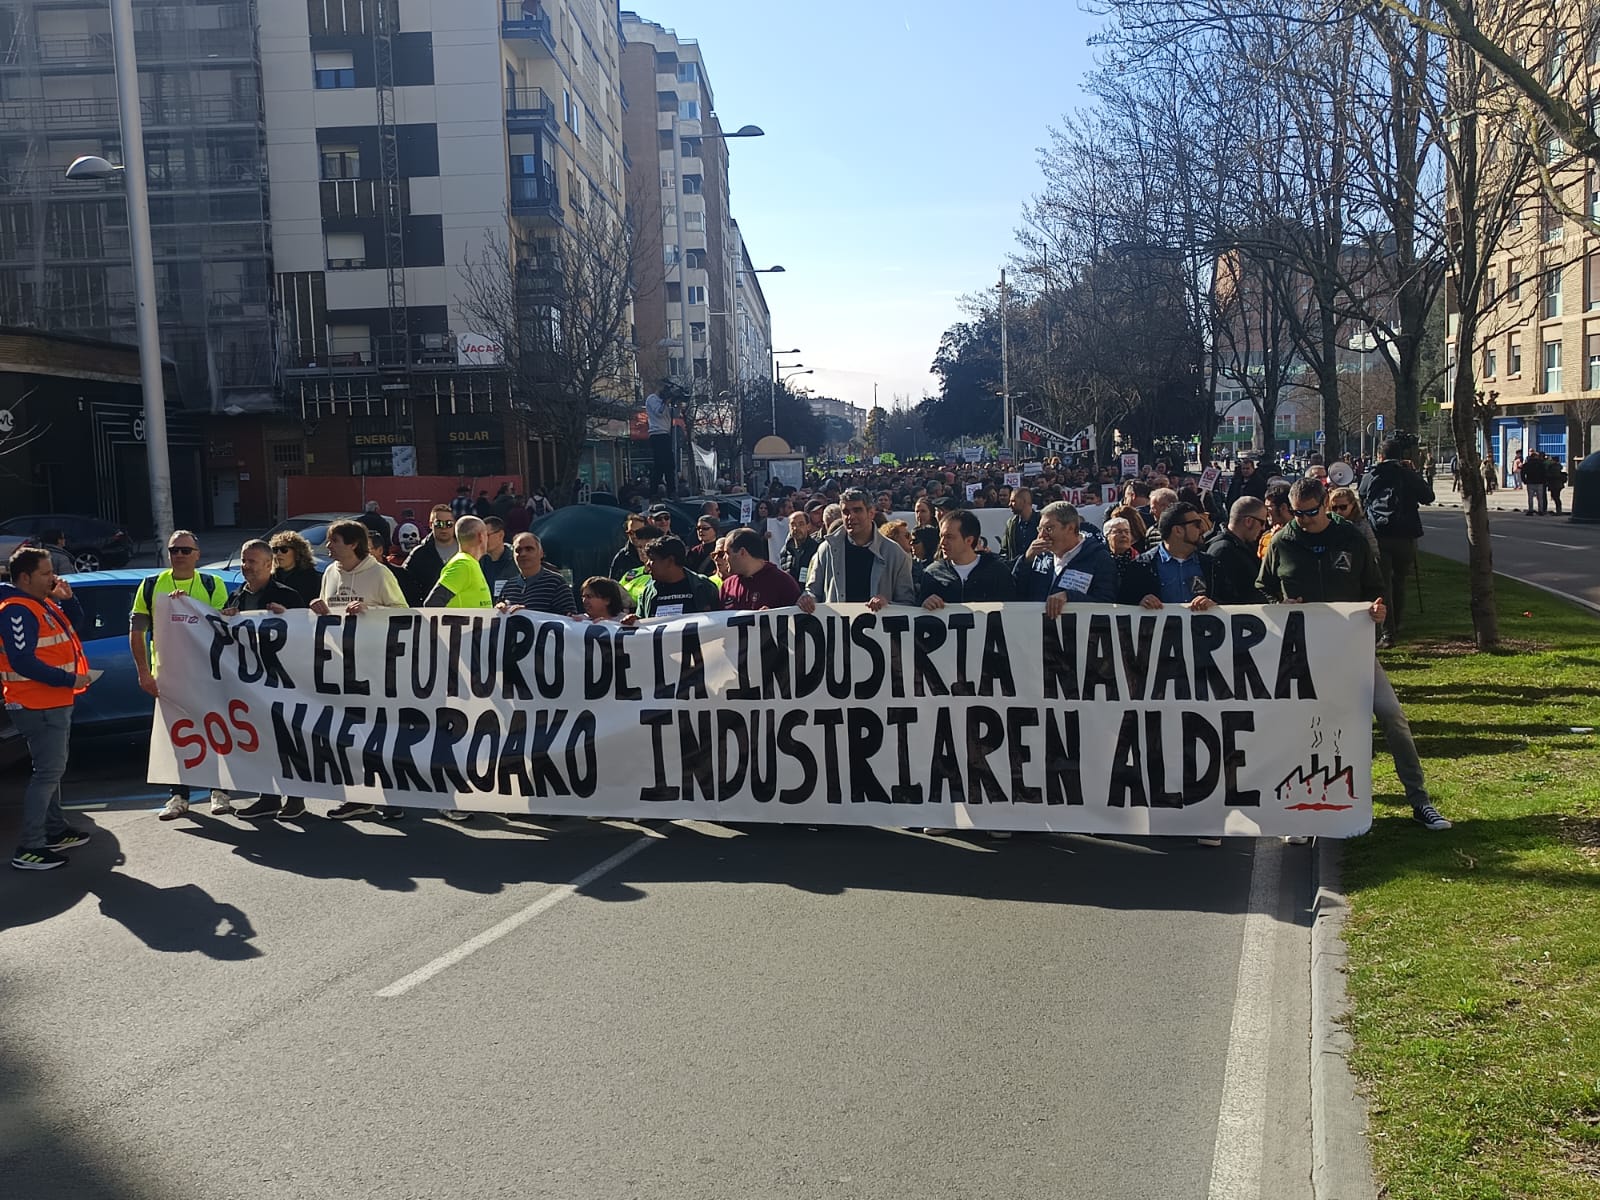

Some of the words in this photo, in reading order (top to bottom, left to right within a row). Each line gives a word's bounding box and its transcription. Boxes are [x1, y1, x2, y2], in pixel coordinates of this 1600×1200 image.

[449, 431, 489, 441] SOLAR
[205, 614, 296, 689] POR
[313, 615, 370, 696] EL
[385, 614, 565, 700] FUTURO
[583, 624, 642, 700] DE
[653, 622, 709, 700] LA
[726, 611, 1017, 700] INDUSTRIA
[1042, 610, 1318, 701] NAVARRA
[170, 699, 259, 769] SOS
[271, 701, 598, 798] NAFARROAKO
[639, 706, 1084, 806] INDUSTRIAREN
[1107, 709, 1261, 809] ALDE
